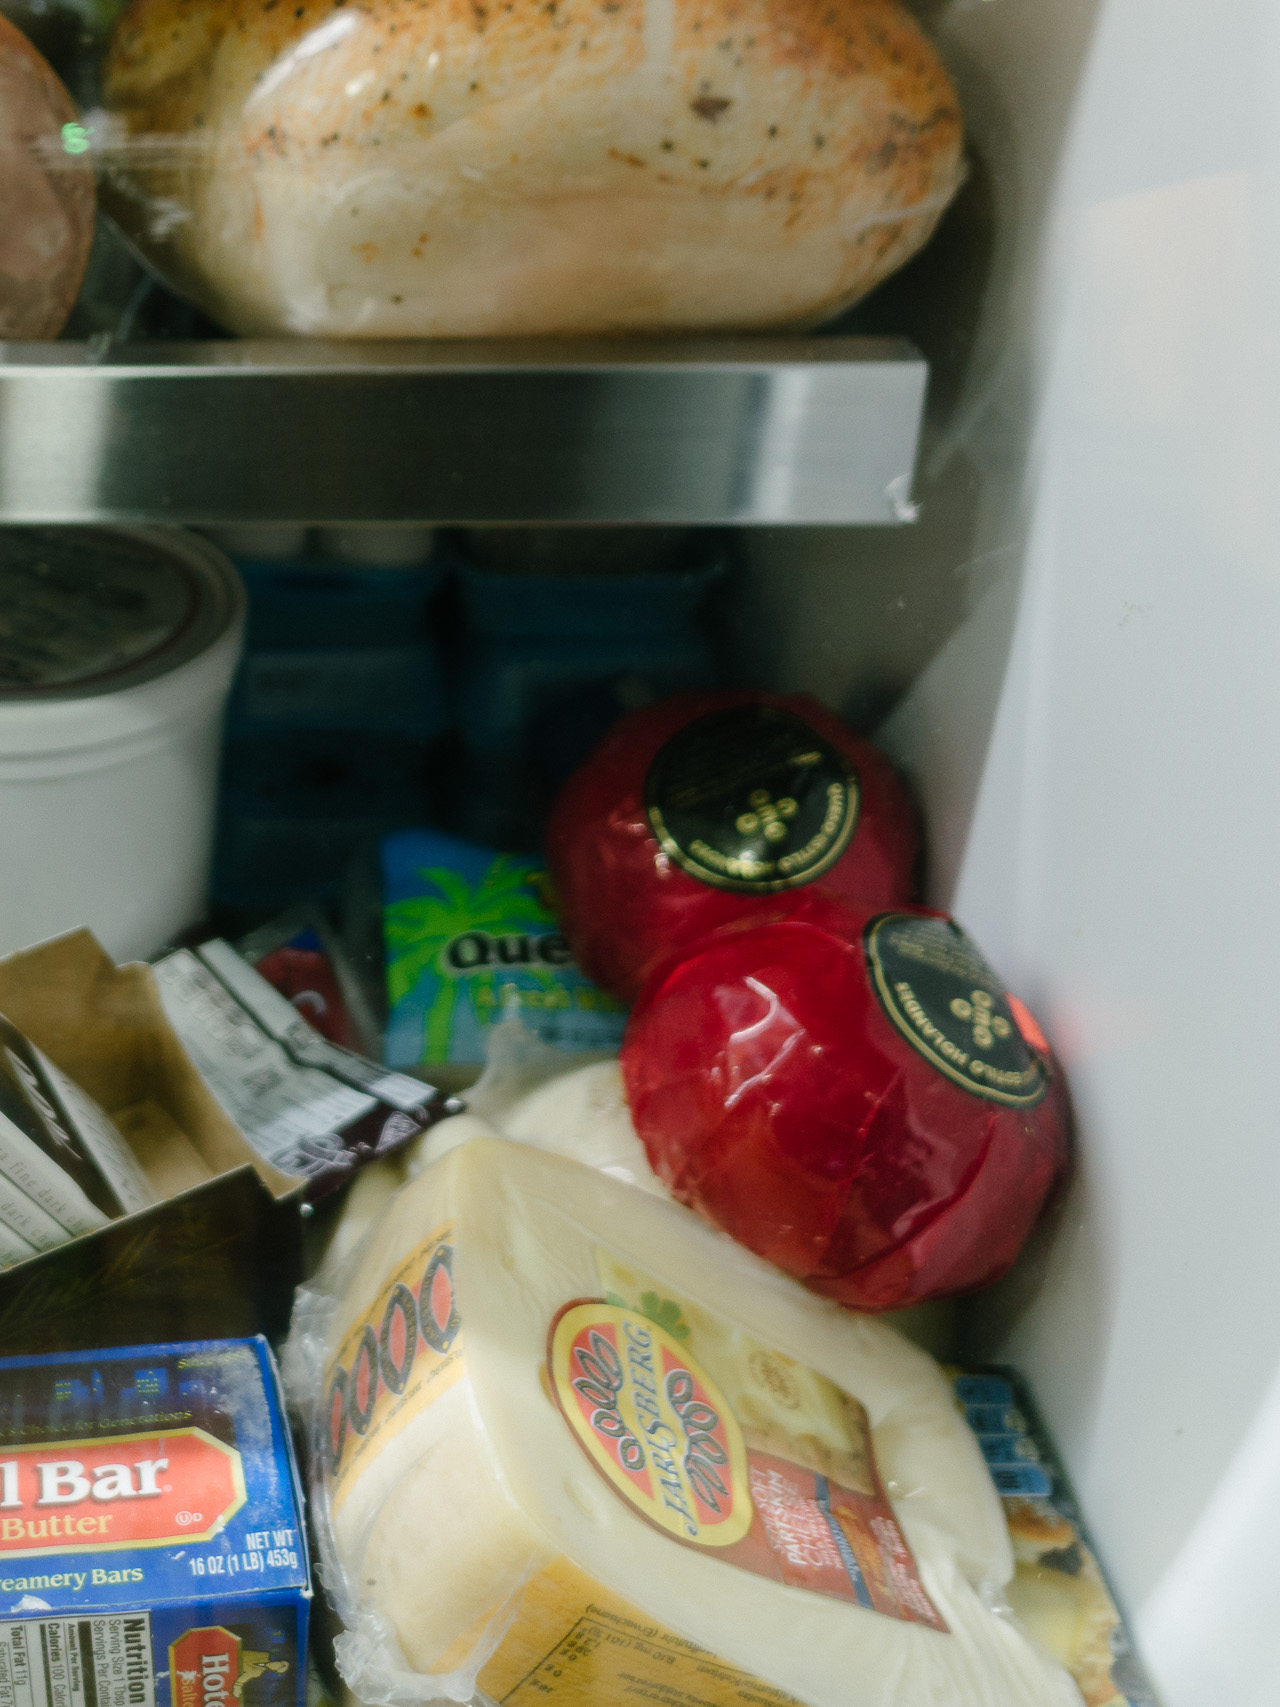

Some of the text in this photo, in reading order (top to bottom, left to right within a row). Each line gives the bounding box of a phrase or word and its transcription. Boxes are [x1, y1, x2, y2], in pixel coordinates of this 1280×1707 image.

[449, 930, 568, 969] Que
[12, 1159, 39, 1189] fine
[38, 1187, 68, 1214] dark
[0, 1200, 31, 1228] dark
[624, 1321, 700, 1537] JARLSBERG
[37, 1457, 170, 1505] Bar
[1, 1511, 114, 1541] Butter
[246, 1530, 295, 1551] NET WT
[91, 1567, 144, 1586] Bars
[189, 1550, 299, 1576] 16 OZ (1 LB) 453g
[10, 1625, 27, 1686] Total Fat 11g
[47, 1622, 65, 1680] Calories 100
[67, 1624, 81, 1692] Amount Per Serving
[93, 1620, 109, 1678] Servings Per
[108, 1619, 127, 1706] Serving Size Tbsp
[123, 1617, 147, 1705] Nutrition
[0, 1685, 12, 1699] Fat
